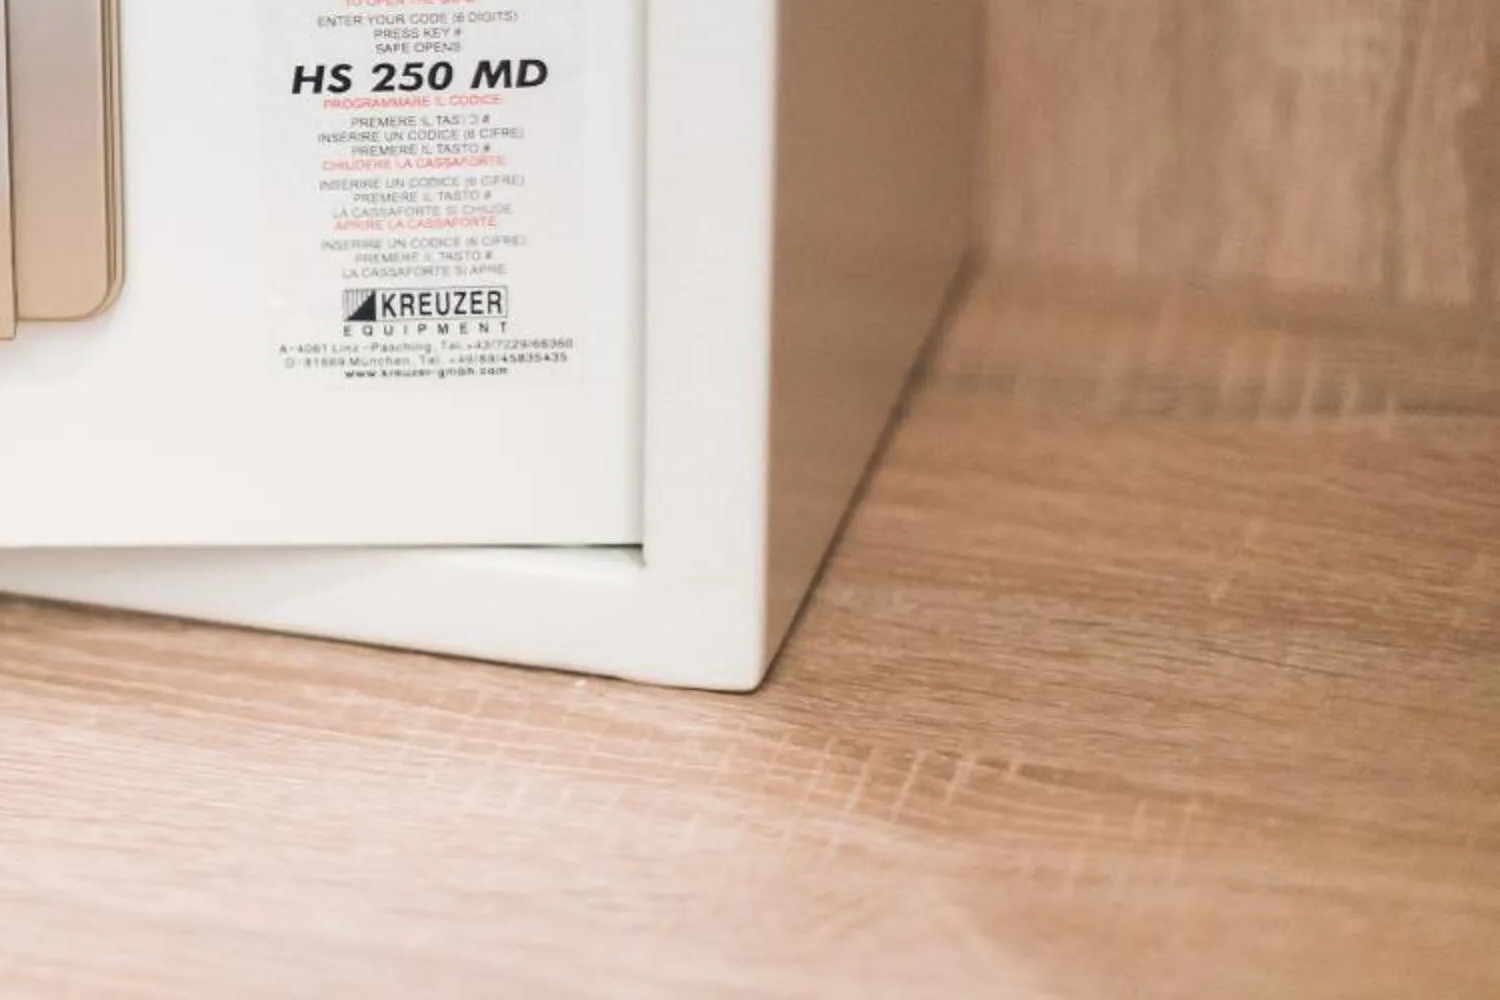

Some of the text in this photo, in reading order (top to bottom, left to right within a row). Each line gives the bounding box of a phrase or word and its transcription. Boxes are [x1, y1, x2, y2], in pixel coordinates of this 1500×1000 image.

[318, 17, 360, 27] ENTER
[367, 15, 405, 26] YOUR
[410, 14, 446, 25] CODE
[468, 12, 517, 23] DIGITS)
[374, 29, 418, 39] PRESS
[424, 28, 449, 38] KEY
[376, 41, 460, 54] SAFE OPENS
[292, 60, 548, 94] HS 250 MD
[352, 116, 416, 128] PREMERE
[318, 133, 379, 144] INSERIRE
[408, 130, 458, 141] CODICE
[352, 145, 416, 156] PREMERE
[437, 144, 479, 155] TASTO
[409, 177, 459, 188] CODICE
[354, 192, 416, 203] PREMERE
[438, 191, 479, 201] TASTO
[411, 238, 460, 249] CODICE
[440, 251, 480, 262] TASTO
[382, 291, 503, 317] KREUZER
[344, 322, 507, 336] EQUIPMENT
